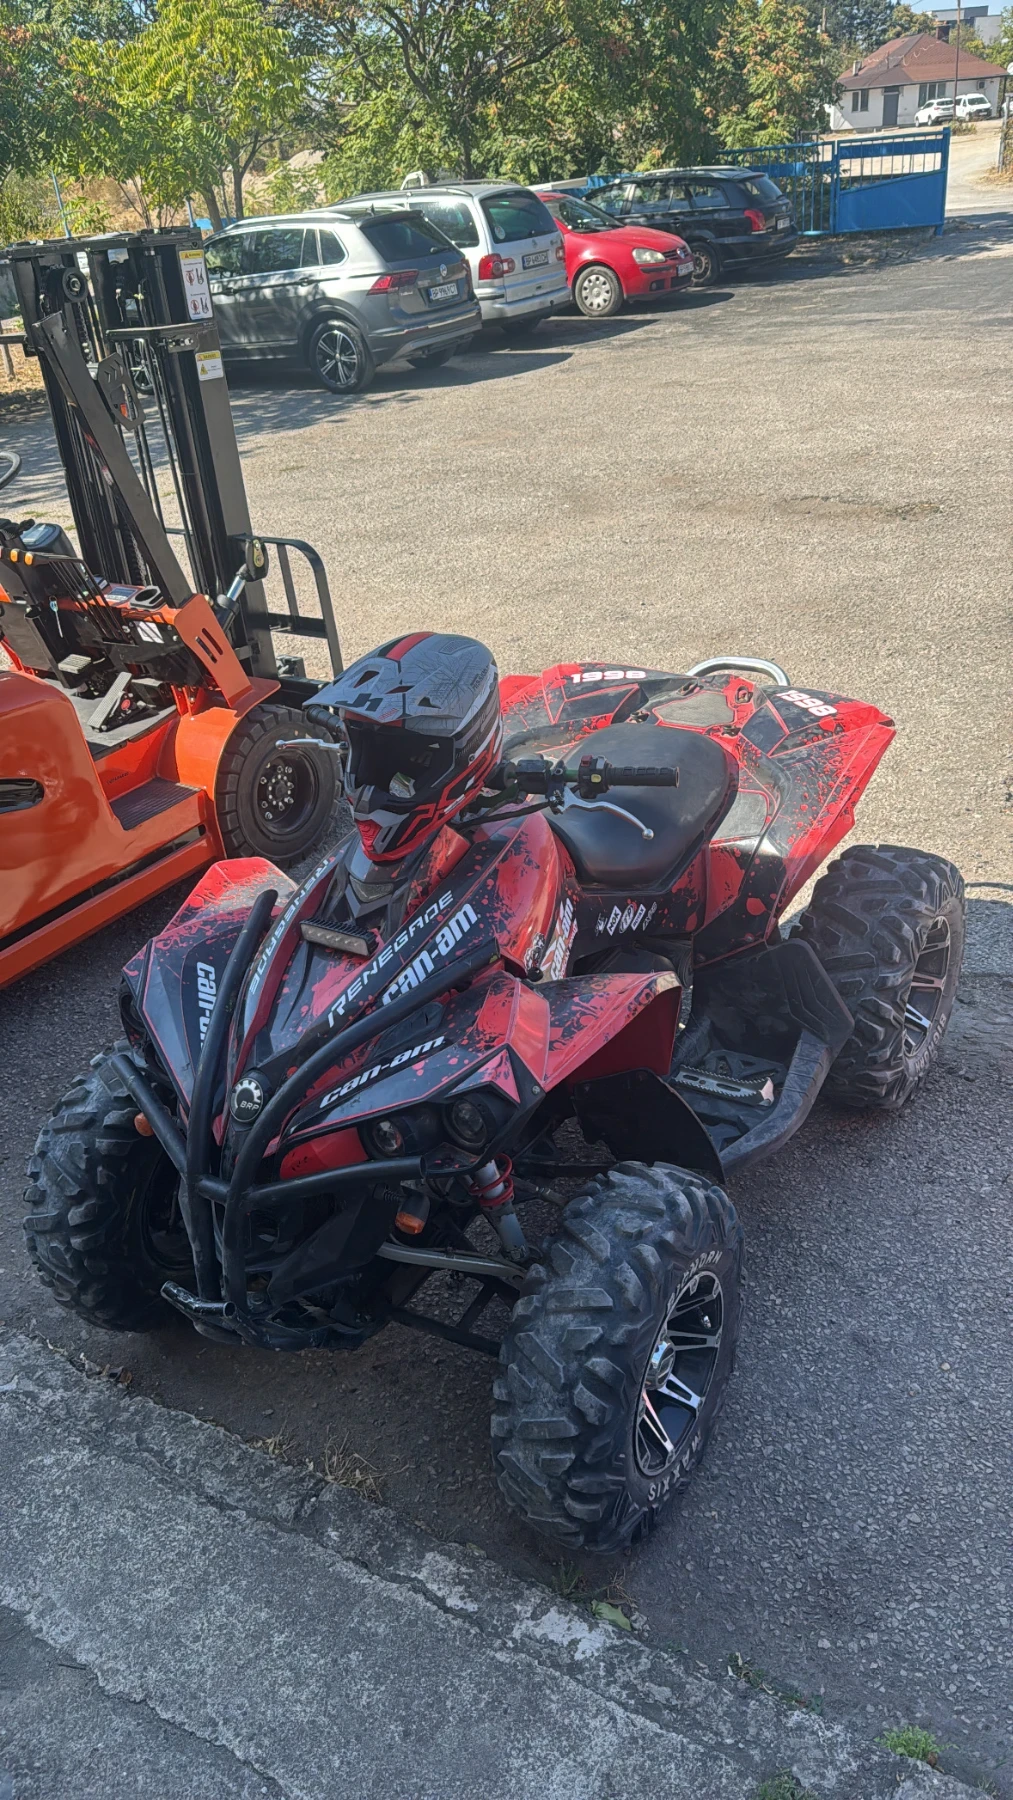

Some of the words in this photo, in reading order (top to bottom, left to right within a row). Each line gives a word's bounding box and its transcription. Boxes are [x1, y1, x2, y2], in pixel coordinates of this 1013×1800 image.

[571, 670, 646, 684] 1998
[775, 690, 838, 717] 1998
[249, 859, 329, 995] RENEGADE
[327, 890, 454, 1028] RENEGADE
[381, 903, 478, 1006] can-am
[319, 1035, 445, 1109] can-am
[914, 1013, 947, 1073] BIGHORN
[240, 1100, 260, 1111] BRP
[667, 1250, 723, 1315] BIGHORN
[648, 1431, 702, 1501] MAXXIS
